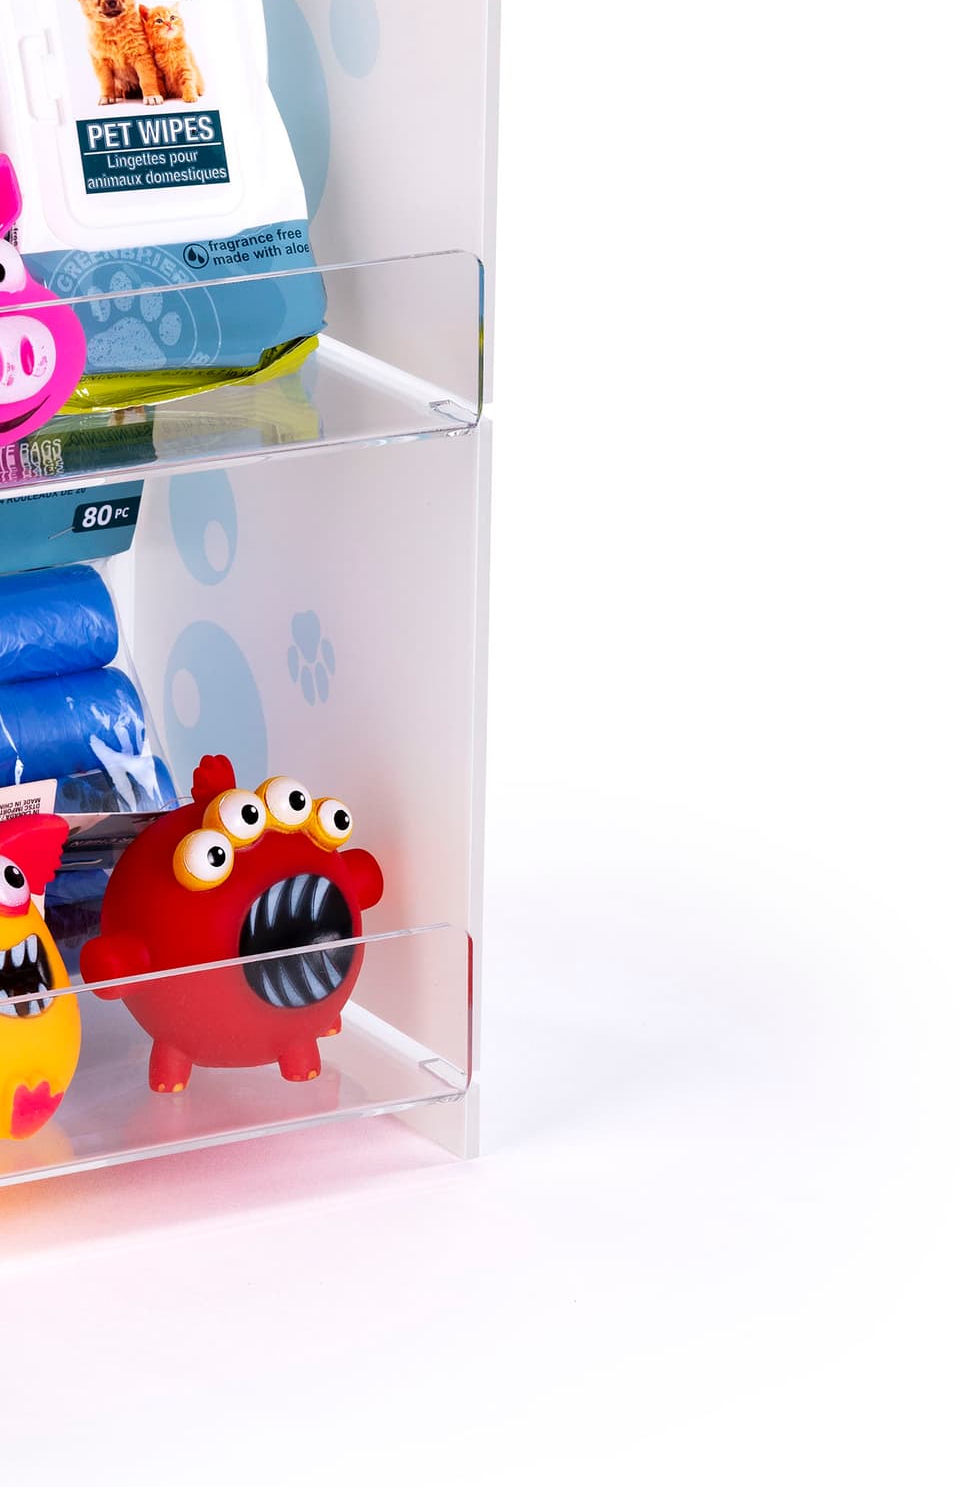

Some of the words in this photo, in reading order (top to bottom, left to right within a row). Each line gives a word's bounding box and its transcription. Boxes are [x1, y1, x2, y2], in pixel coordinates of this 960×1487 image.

[87, 121, 131, 149] PET
[136, 116, 215, 145] WIPES
[107, 152, 166, 170] Lingettes
[169, 151, 199, 167] pour
[87, 172, 142, 189] animaux
[146, 166, 228, 185] domestiques
[208, 231, 274, 252] fragrance
[276, 227, 302, 240] free
[212, 252, 250, 266] made
[253, 245, 282, 259] with
[285, 242, 309, 255] aloe
[20, 438, 62, 457] BAGS
[82, 504, 112, 528] 80
[115, 507, 130, 519] PC
[23, 797, 41, 807] MADE
